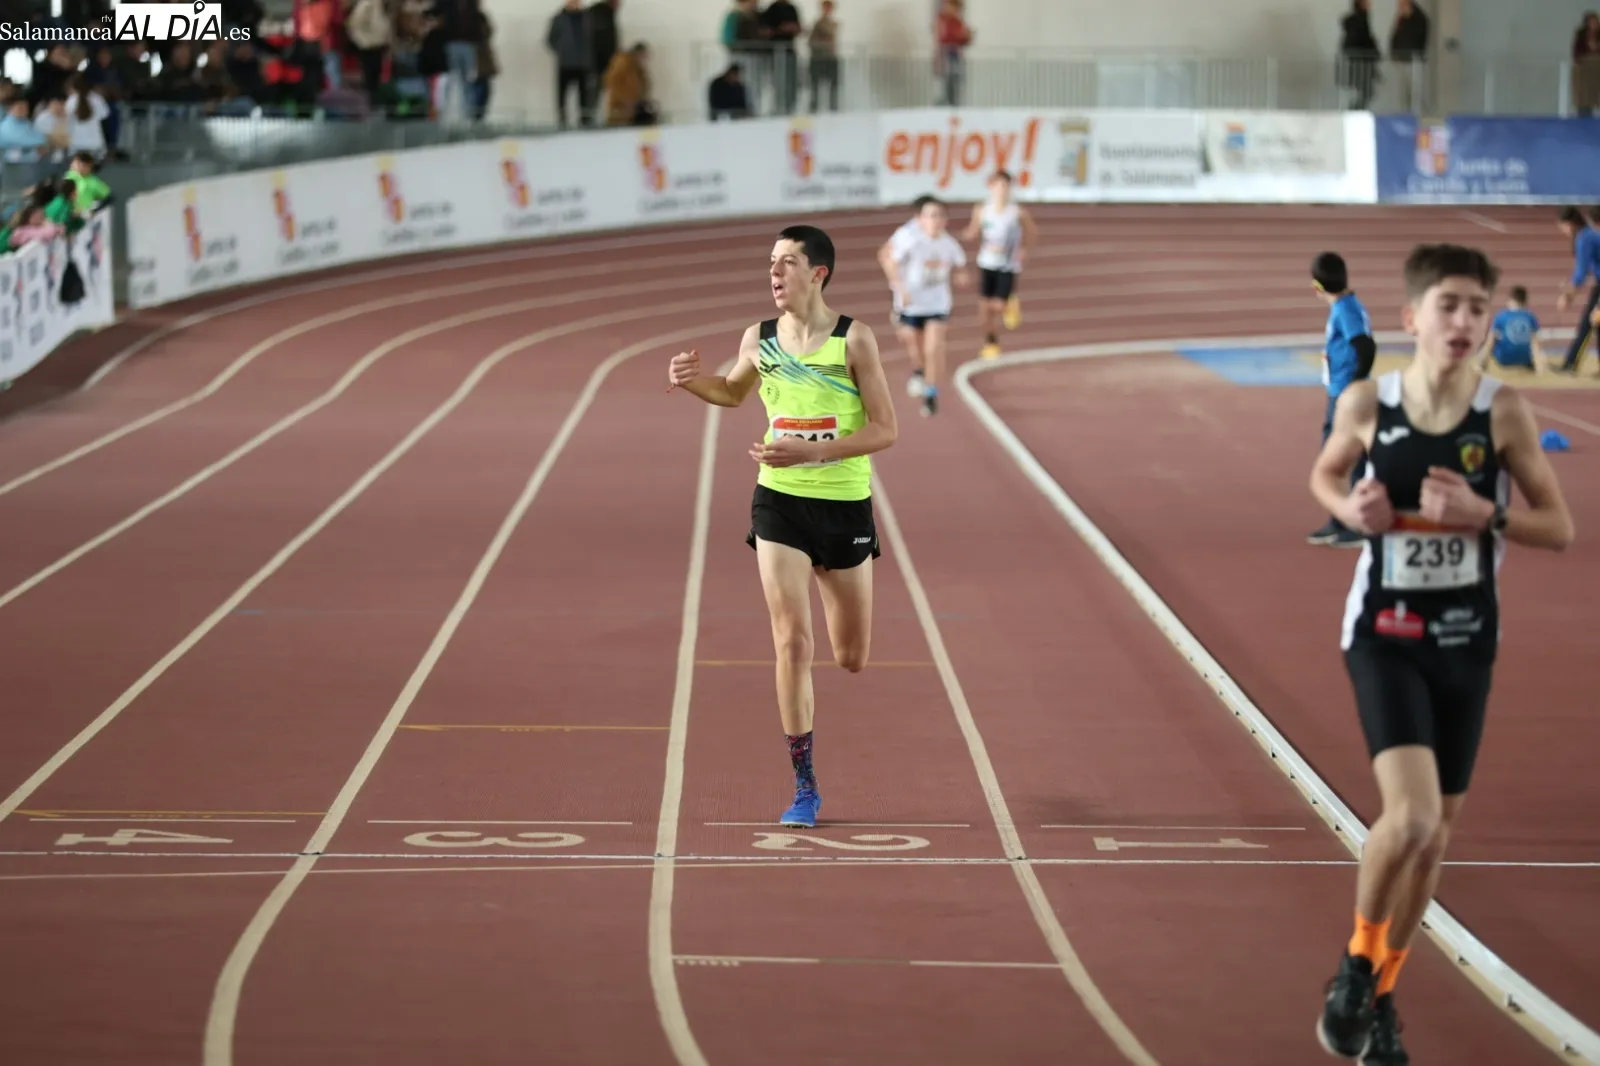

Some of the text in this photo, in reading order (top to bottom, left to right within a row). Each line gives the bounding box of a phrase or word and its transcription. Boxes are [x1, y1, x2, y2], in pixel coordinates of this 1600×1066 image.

[886, 116, 1040, 188] enjoy!
[1405, 538, 1464, 568] 239
[56, 828, 232, 846] 4
[403, 831, 585, 848] 3
[752, 832, 930, 851] 2
[1094, 836, 1268, 851] 1
